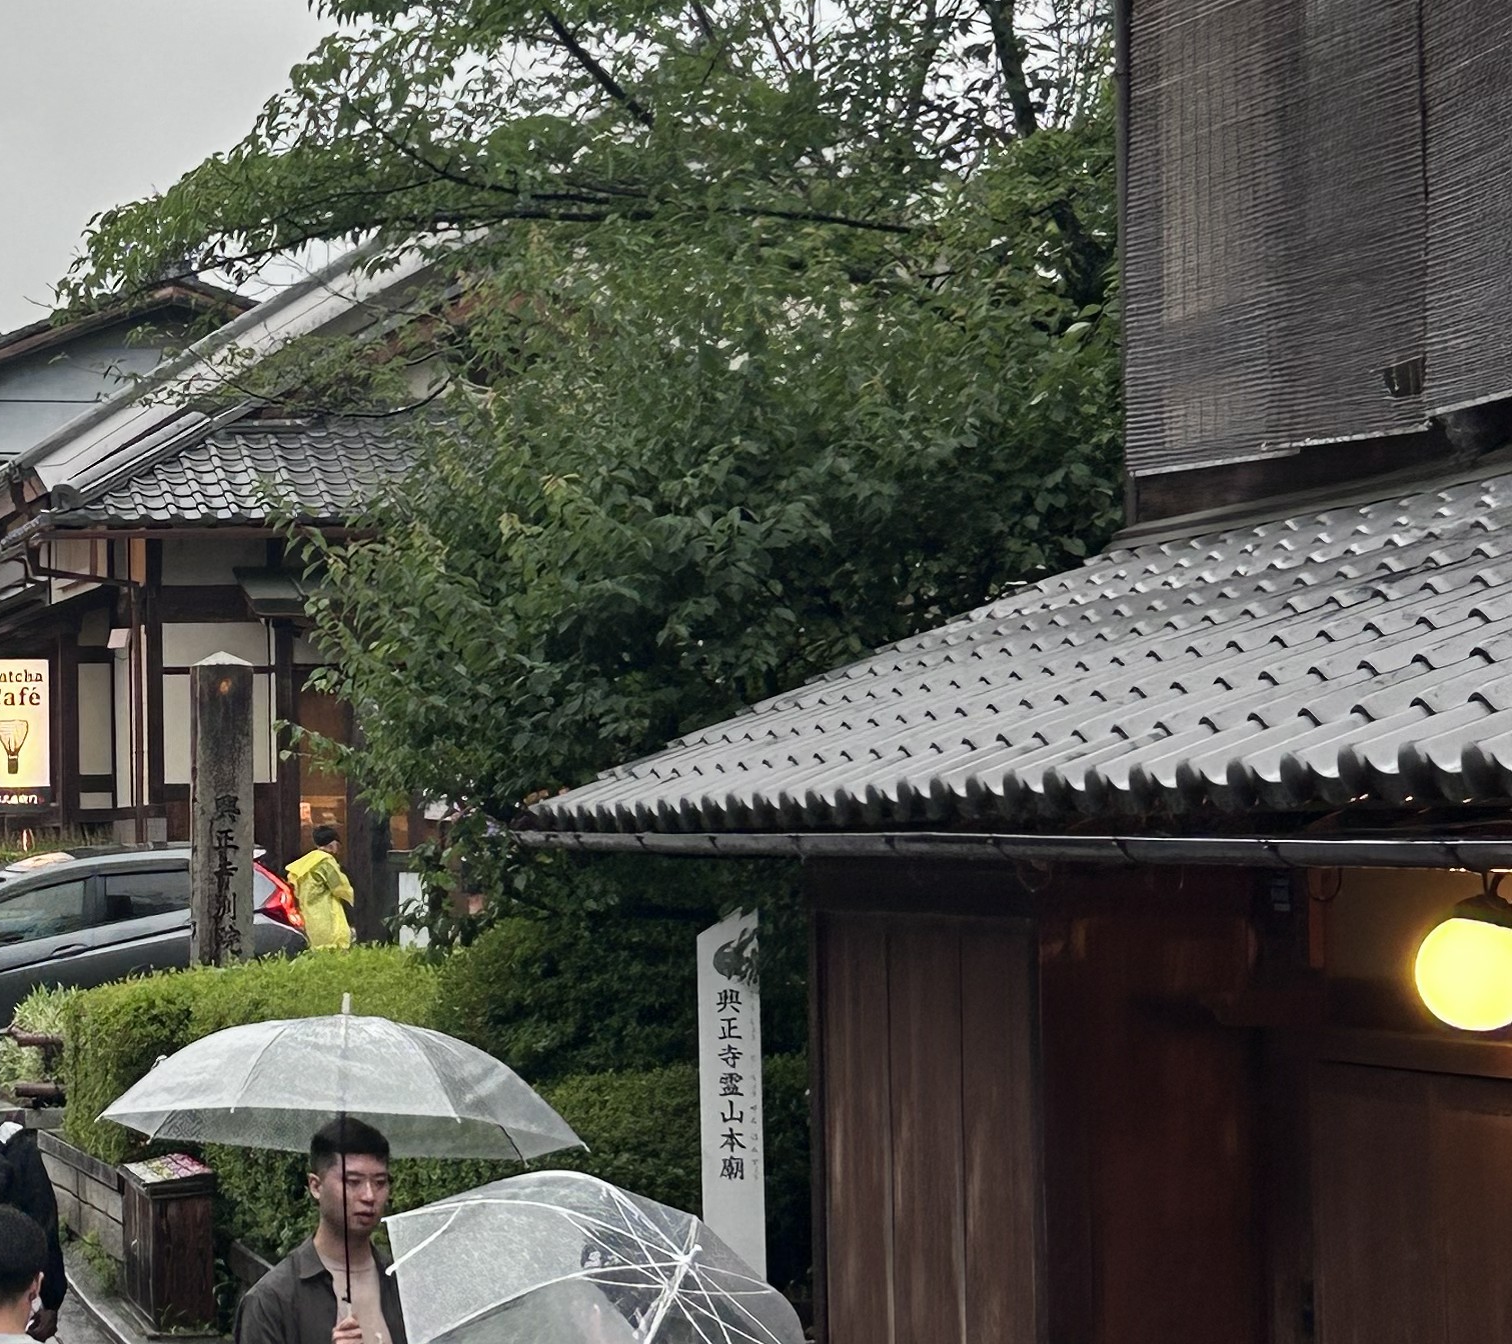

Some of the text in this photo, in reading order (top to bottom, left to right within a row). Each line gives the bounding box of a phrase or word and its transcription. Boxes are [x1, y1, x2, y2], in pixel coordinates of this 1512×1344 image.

[716, 988, 747, 1181] 興正寺霊山本廟
